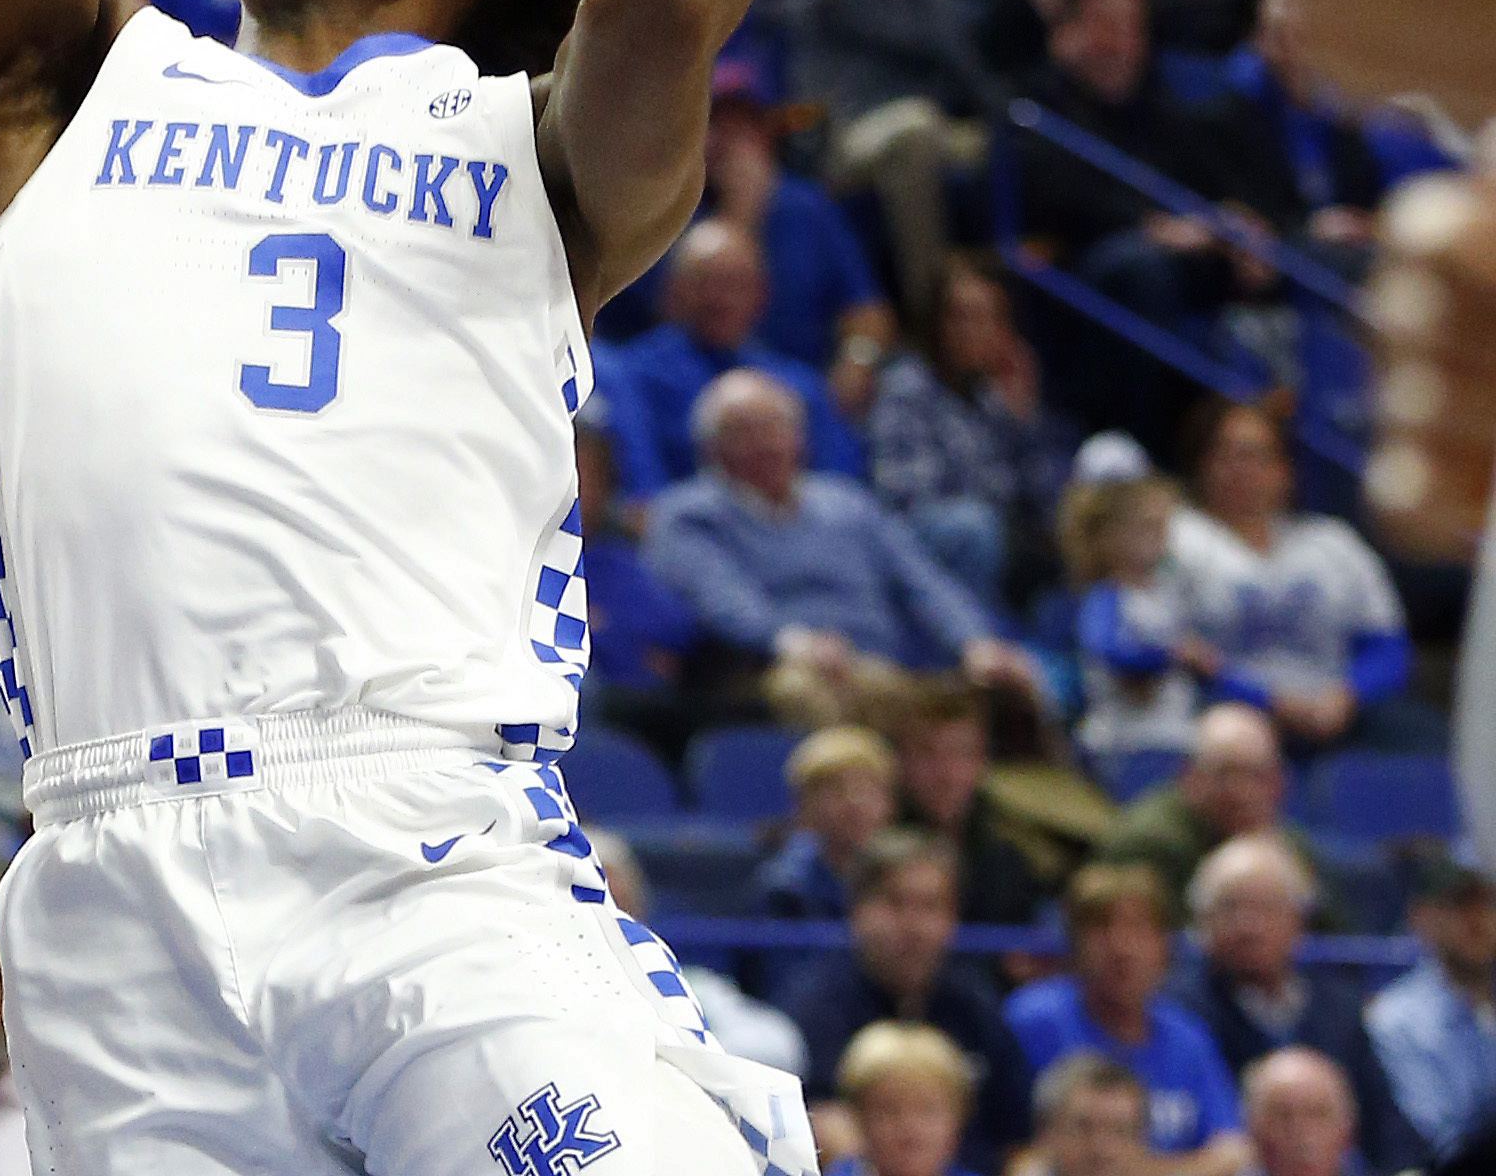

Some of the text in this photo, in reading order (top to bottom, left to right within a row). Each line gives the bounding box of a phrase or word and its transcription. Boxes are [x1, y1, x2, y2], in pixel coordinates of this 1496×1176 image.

[429, 89, 472, 119] SEC
[92, 118, 510, 240] KENTUCKY
[235, 231, 349, 415] 3
